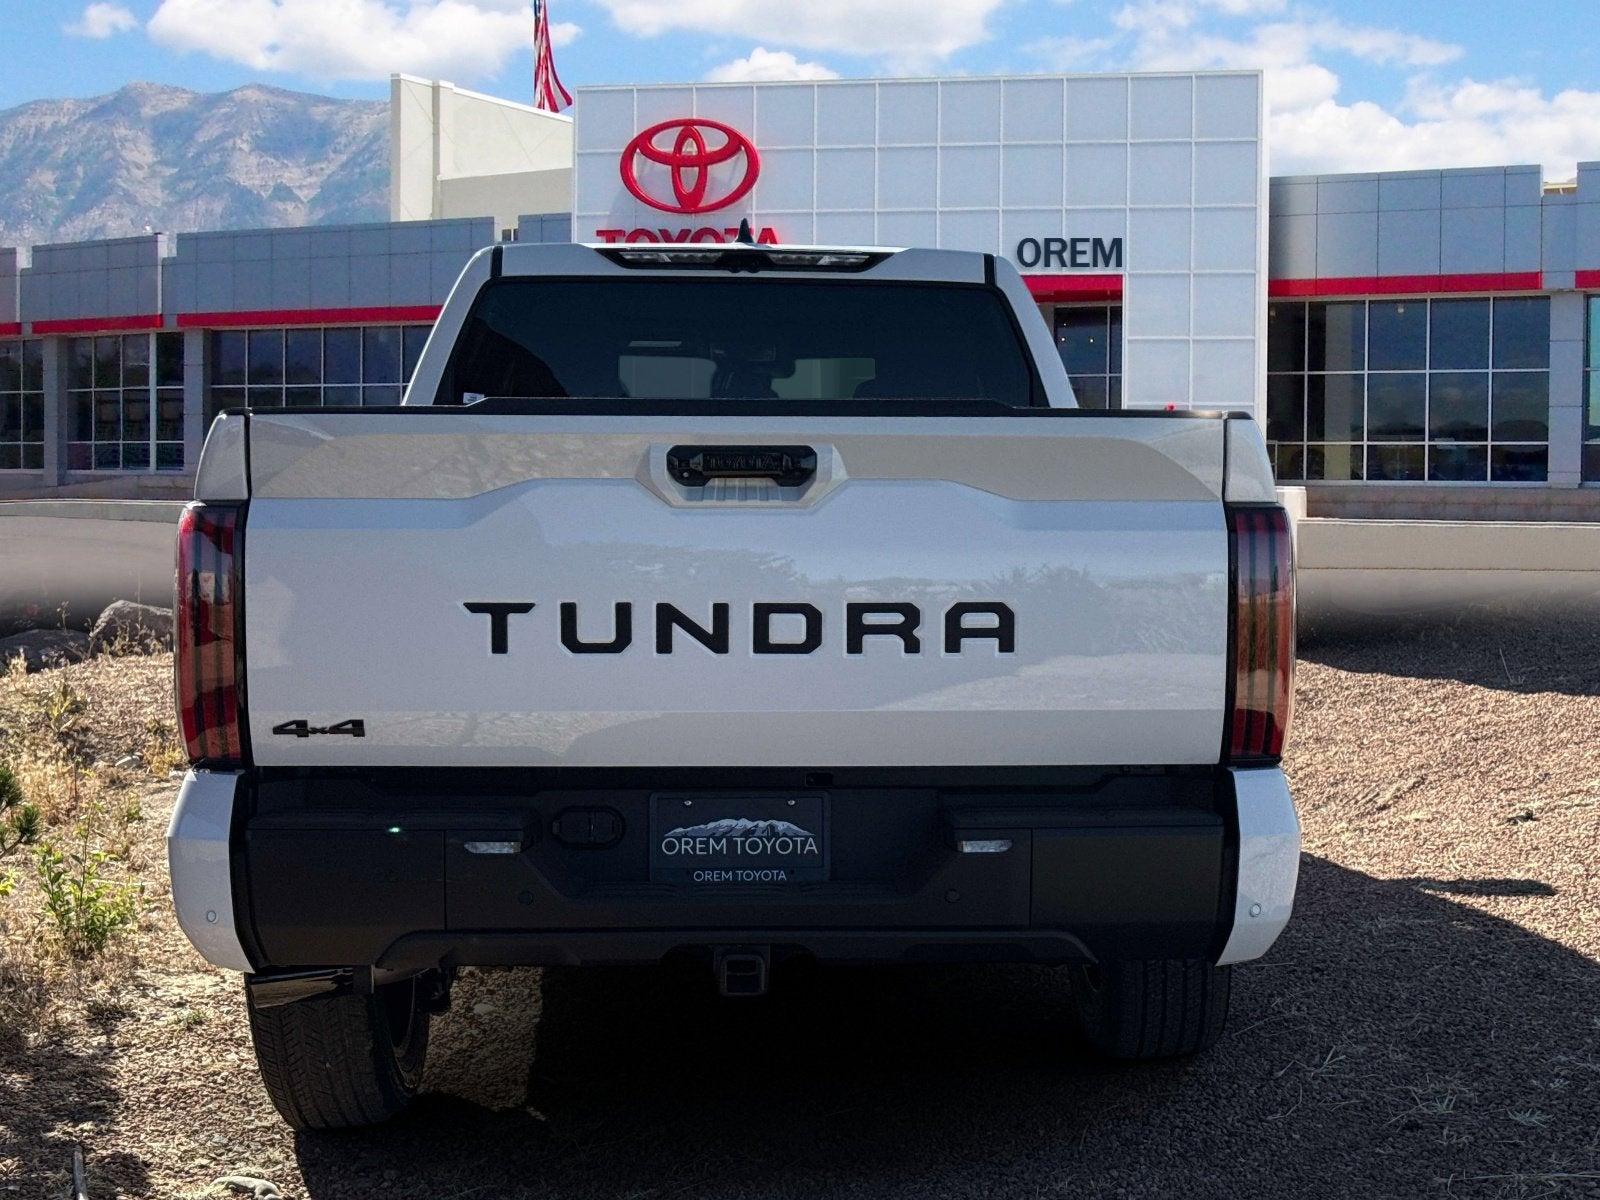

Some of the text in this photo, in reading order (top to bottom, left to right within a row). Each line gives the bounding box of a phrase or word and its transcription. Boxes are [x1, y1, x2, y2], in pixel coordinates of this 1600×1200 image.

[1017, 237, 1123, 268] OREM
[463, 602, 1016, 655] TUNDRA
[661, 837, 819, 855] OREM TOYOTA
[693, 869, 787, 882] OREM TOYOTA
